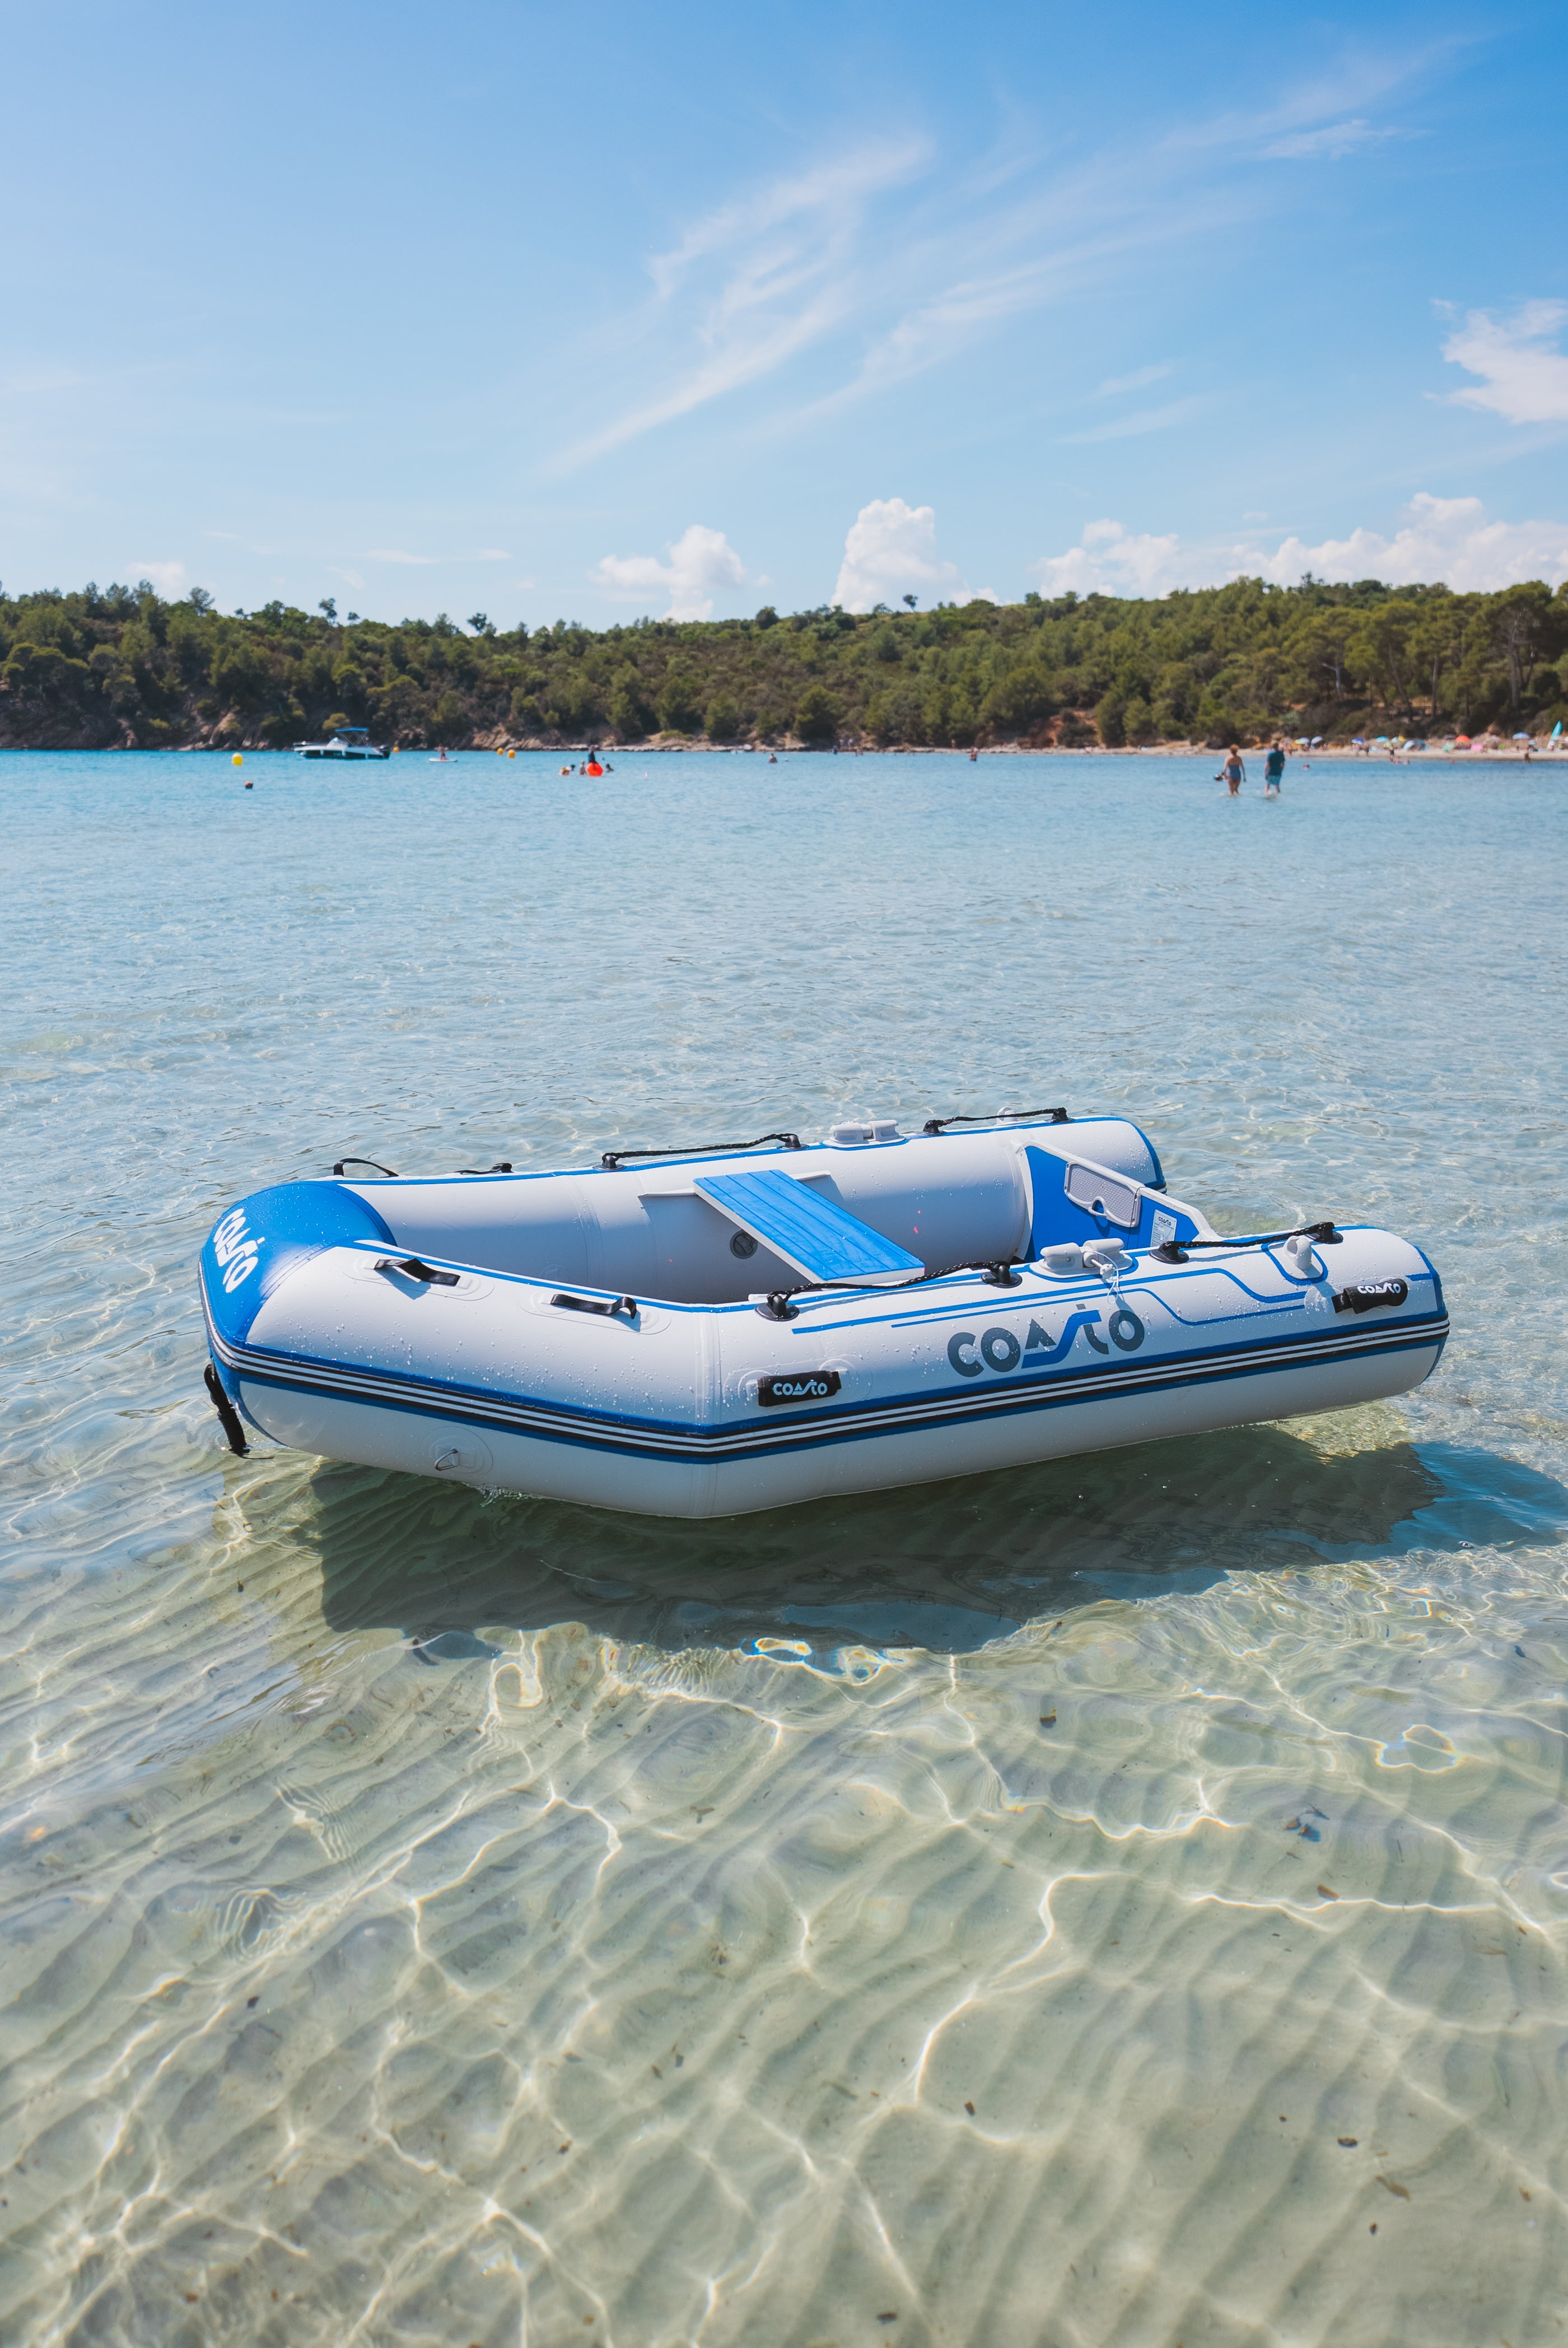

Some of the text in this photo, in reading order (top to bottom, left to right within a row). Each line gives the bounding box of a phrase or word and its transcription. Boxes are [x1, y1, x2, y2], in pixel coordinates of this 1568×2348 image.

[213, 1208, 265, 1293] COASTO
[1356, 1282, 1401, 1294] COASTO
[947, 1303, 1145, 1378] COASTO
[773, 1380, 828, 1396] COASTO
